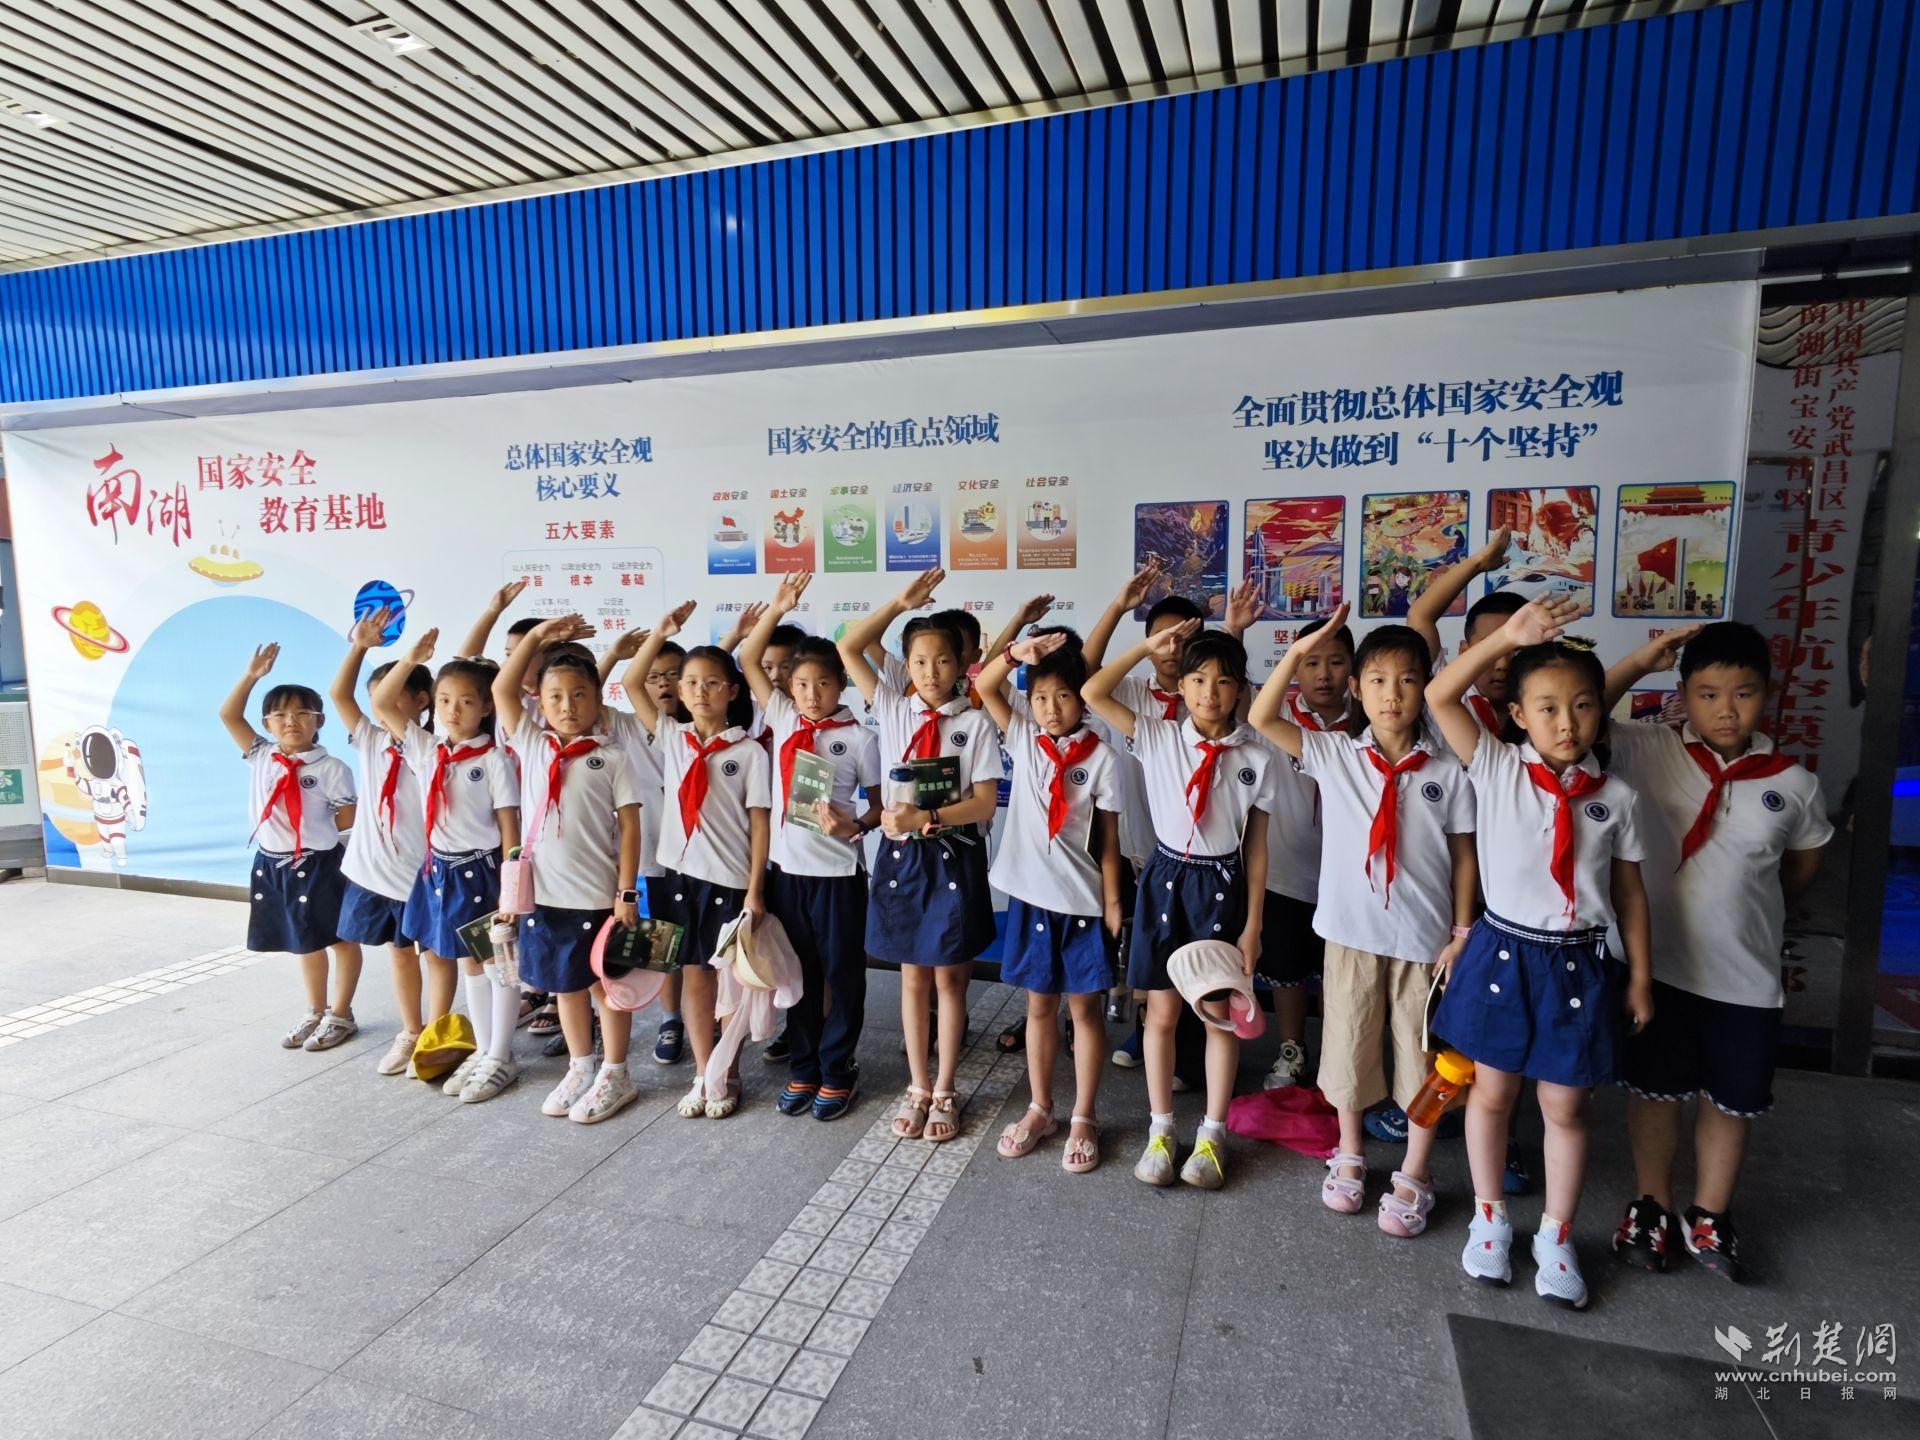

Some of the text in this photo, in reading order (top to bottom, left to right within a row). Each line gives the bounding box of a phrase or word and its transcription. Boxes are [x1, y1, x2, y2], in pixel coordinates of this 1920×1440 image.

[1232, 369, 1625, 430] 全面贯彻总体国家安全观
[1782, 303, 1827, 512] 南湖街宝安社区
[1818, 297, 1867, 511] 中国共产党武昌区
[767, 412, 1000, 457] 国家安全的重点领域
[504, 436, 654, 472] 总体国家安全观
[197, 448, 318, 492] 国家安全
[1025, 476, 1070, 488] 社会安全
[86, 442, 193, 548] 南湖
[535, 472, 622, 502] 核心要义
[712, 491, 749, 502] 政治安全
[769, 488, 808, 499] 国土安全
[892, 482, 934, 494] 经济安全
[958, 479, 1000, 491] 文化安全
[259, 491, 388, 535] 教育基地
[545, 519, 616, 541] 五大要素
[570, 574, 594, 587] 根本
[621, 573, 646, 586] 基础
[603, 618, 627, 631] 依托
